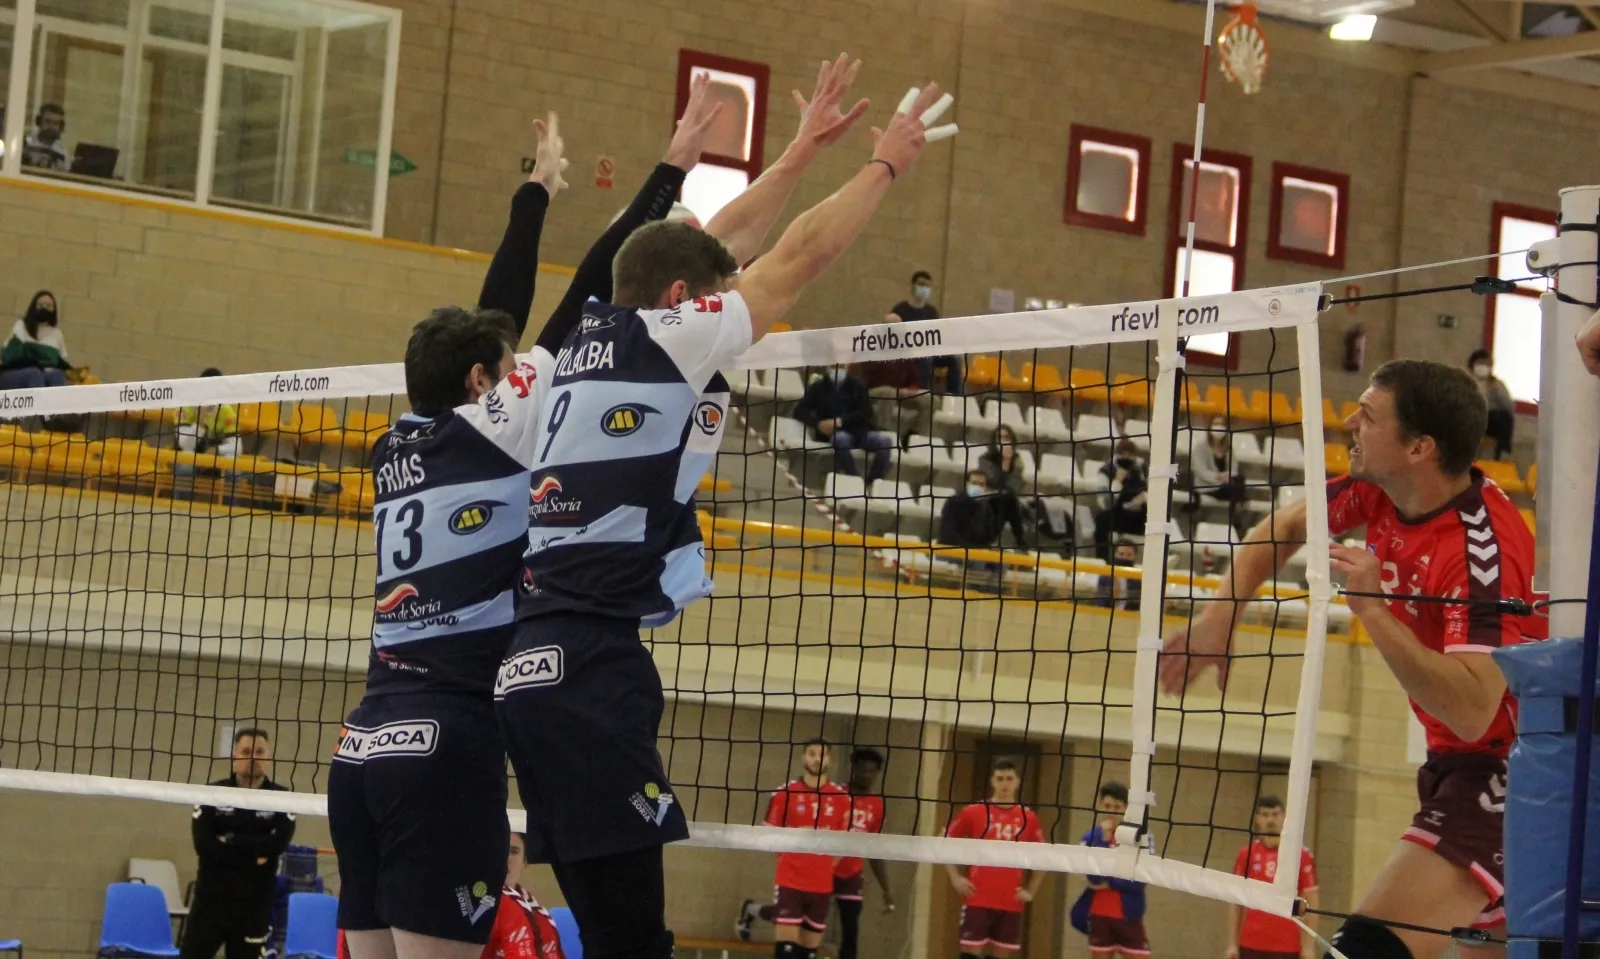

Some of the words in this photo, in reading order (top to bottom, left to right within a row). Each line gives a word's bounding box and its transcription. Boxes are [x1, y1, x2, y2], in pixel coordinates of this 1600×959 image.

[1111, 304, 1219, 332] rfevcom
[852, 327, 942, 353] rfevb.com
[555, 341, 614, 377] VILLALBA
[119, 384, 173, 403] rfevb.com
[268, 373, 329, 393] rfevb.com
[540, 390, 572, 463] 9
[376, 453, 425, 495] FRÍAS
[549, 496, 582, 513] Soria
[375, 499, 425, 577] 13
[409, 598, 441, 618] Soria
[631, 799, 651, 823] SORIA
[456, 891, 469, 917] SORIA
